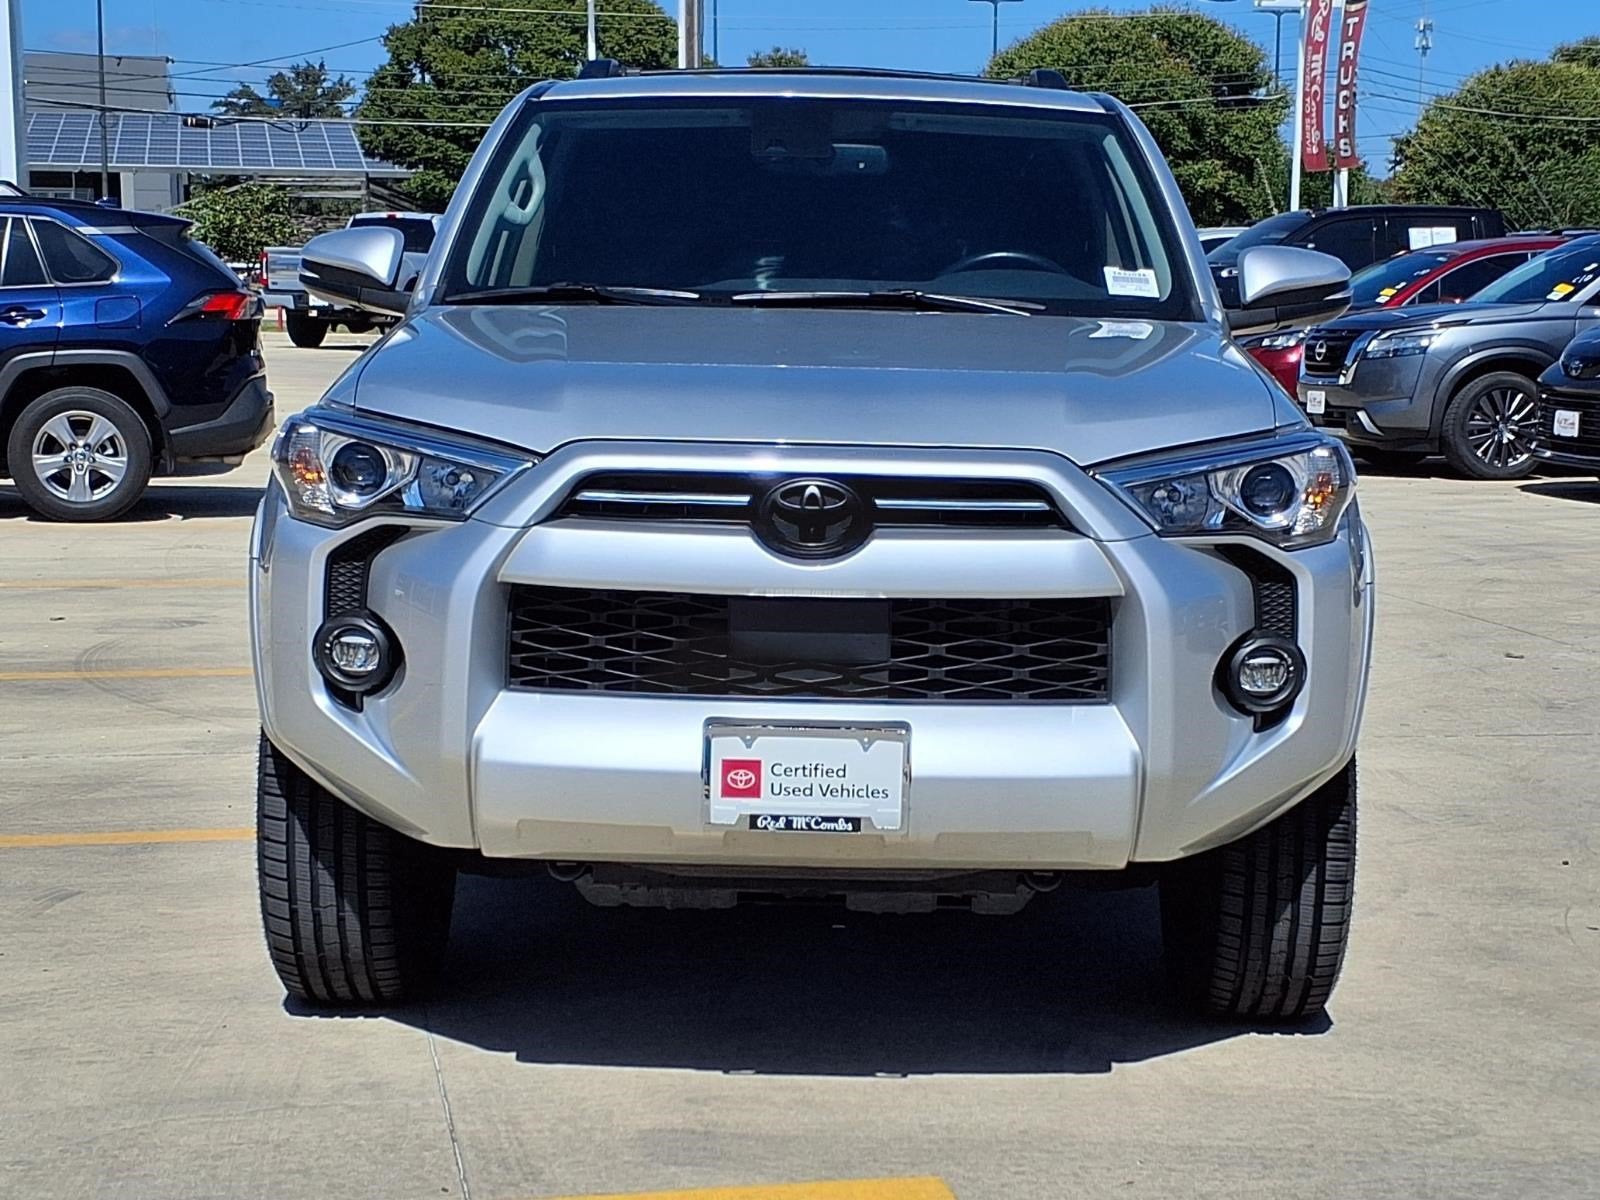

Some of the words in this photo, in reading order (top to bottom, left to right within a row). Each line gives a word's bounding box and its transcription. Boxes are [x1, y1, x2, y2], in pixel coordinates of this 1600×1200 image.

[1304, 46, 1312, 92] DRIVEN
[1338, 16, 1359, 158] TRUCKS
[1304, 97, 1311, 113] TO
[1304, 118, 1312, 155] SERVE
[770, 762, 847, 778] Certified
[770, 782, 814, 798] Used
[819, 783, 889, 799] Vehicles
[757, 815, 786, 831] Red
[788, 816, 853, 831] McCombs
